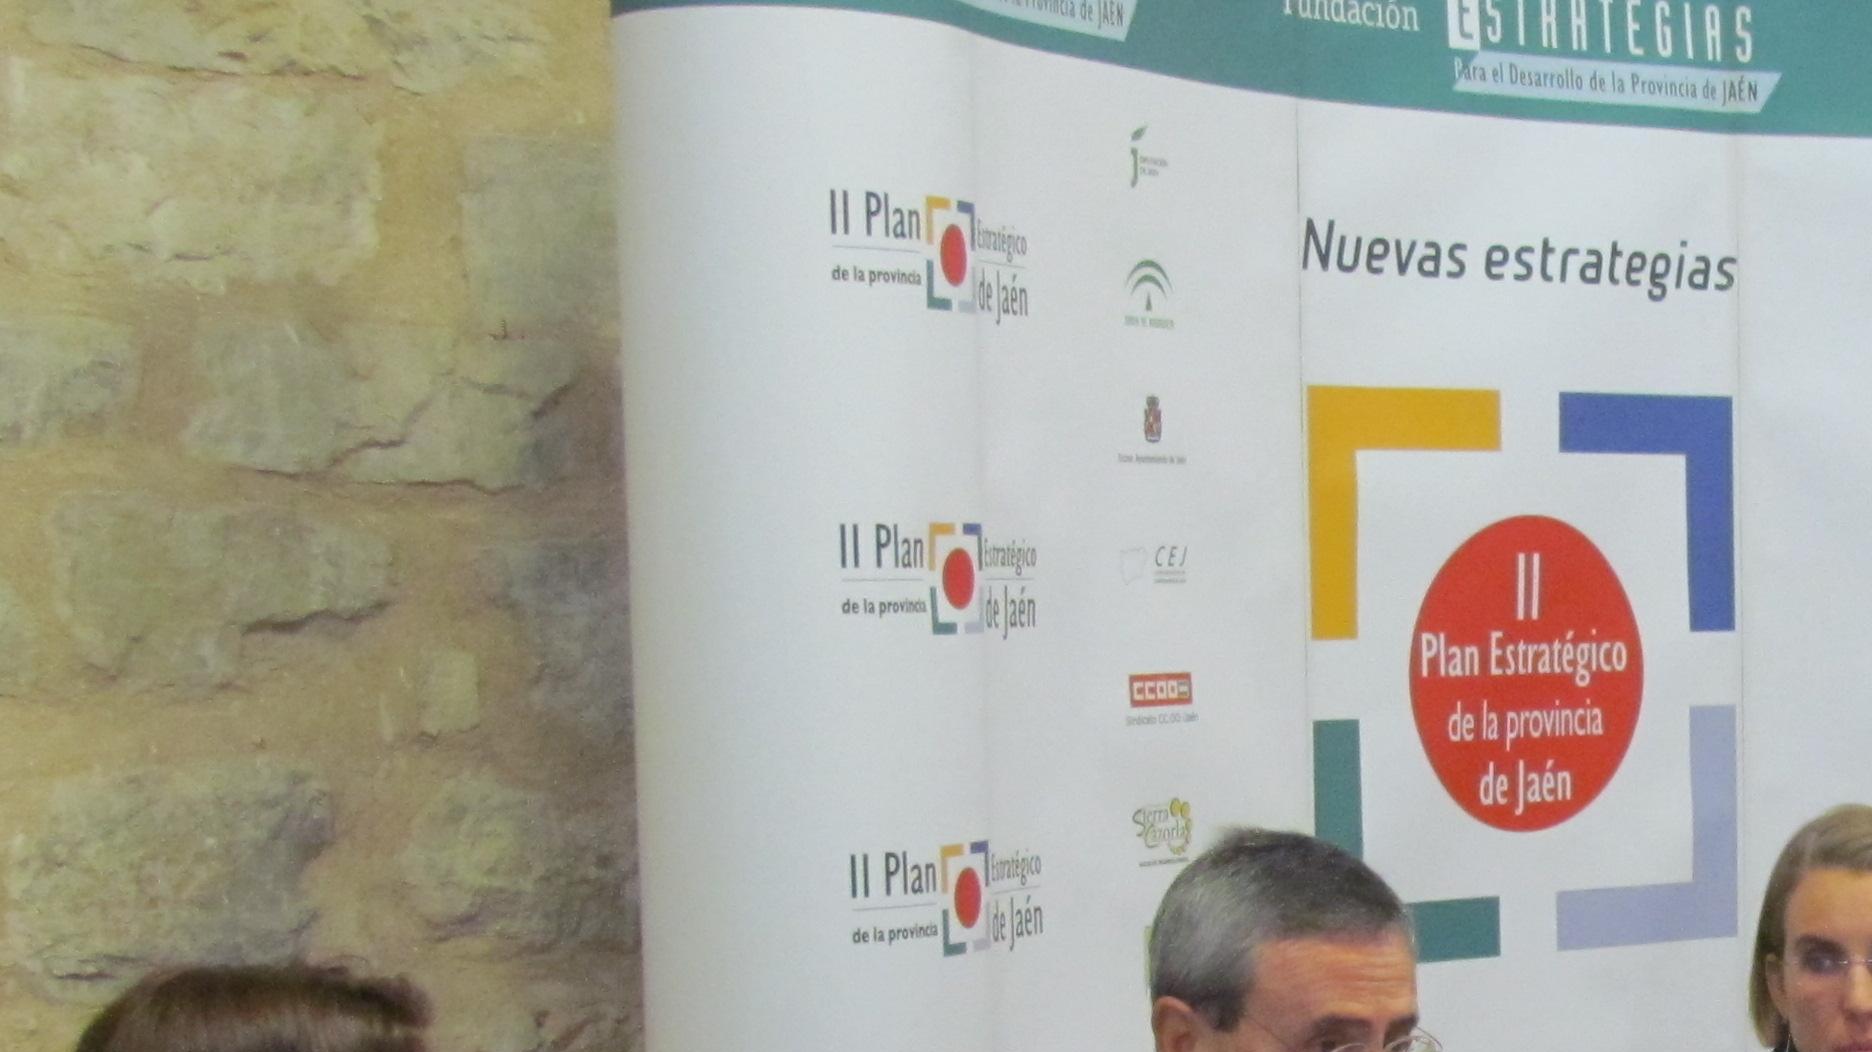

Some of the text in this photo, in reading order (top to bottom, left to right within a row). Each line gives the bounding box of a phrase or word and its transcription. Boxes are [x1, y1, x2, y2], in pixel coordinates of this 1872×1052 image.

[1454, 56, 1758, 107] Para el Desarrollo de la Provincia de JAÉN
[865, 190, 921, 240] Plan
[1302, 218, 1736, 301] Nuevas estrategias
[831, 265, 1029, 326] de la provincia de Jaén
[876, 523, 925, 569] Plan
[841, 585, 1036, 641] de la provincia de Jaén
[1517, 552, 1540, 620] II
[1421, 628, 1628, 688] Plan Estratégico
[1448, 699, 1604, 751] de la provincia
[1479, 759, 1572, 816] de Jaén
[885, 851, 937, 897] Plan
[852, 894, 1044, 952] de la provincia de Jaén
